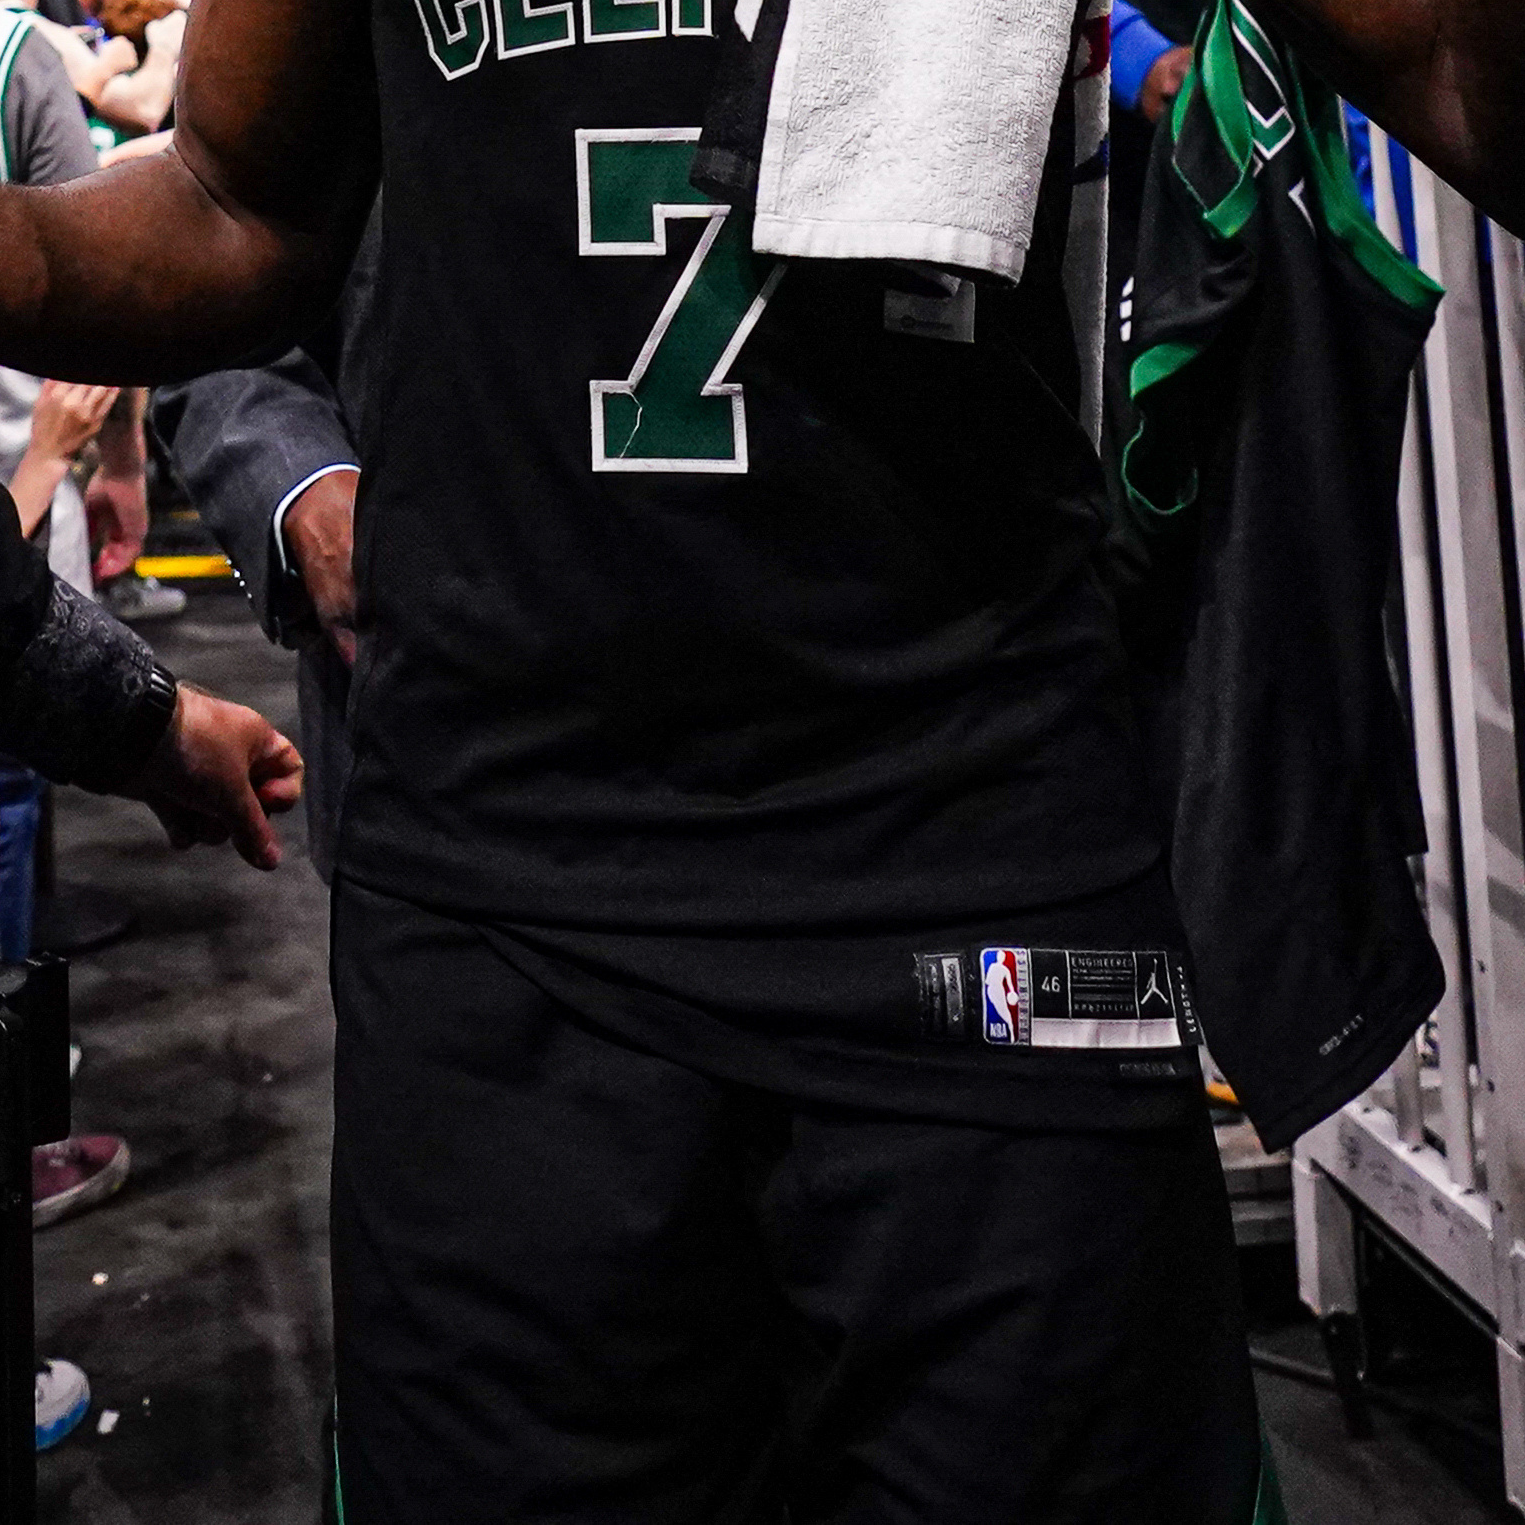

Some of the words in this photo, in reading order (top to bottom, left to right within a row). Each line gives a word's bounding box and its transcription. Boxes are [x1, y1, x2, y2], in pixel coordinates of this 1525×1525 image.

[574, 127, 789, 474] 7
[1041, 975, 1061, 993] 46
[989, 1022, 1008, 1038] NBA
